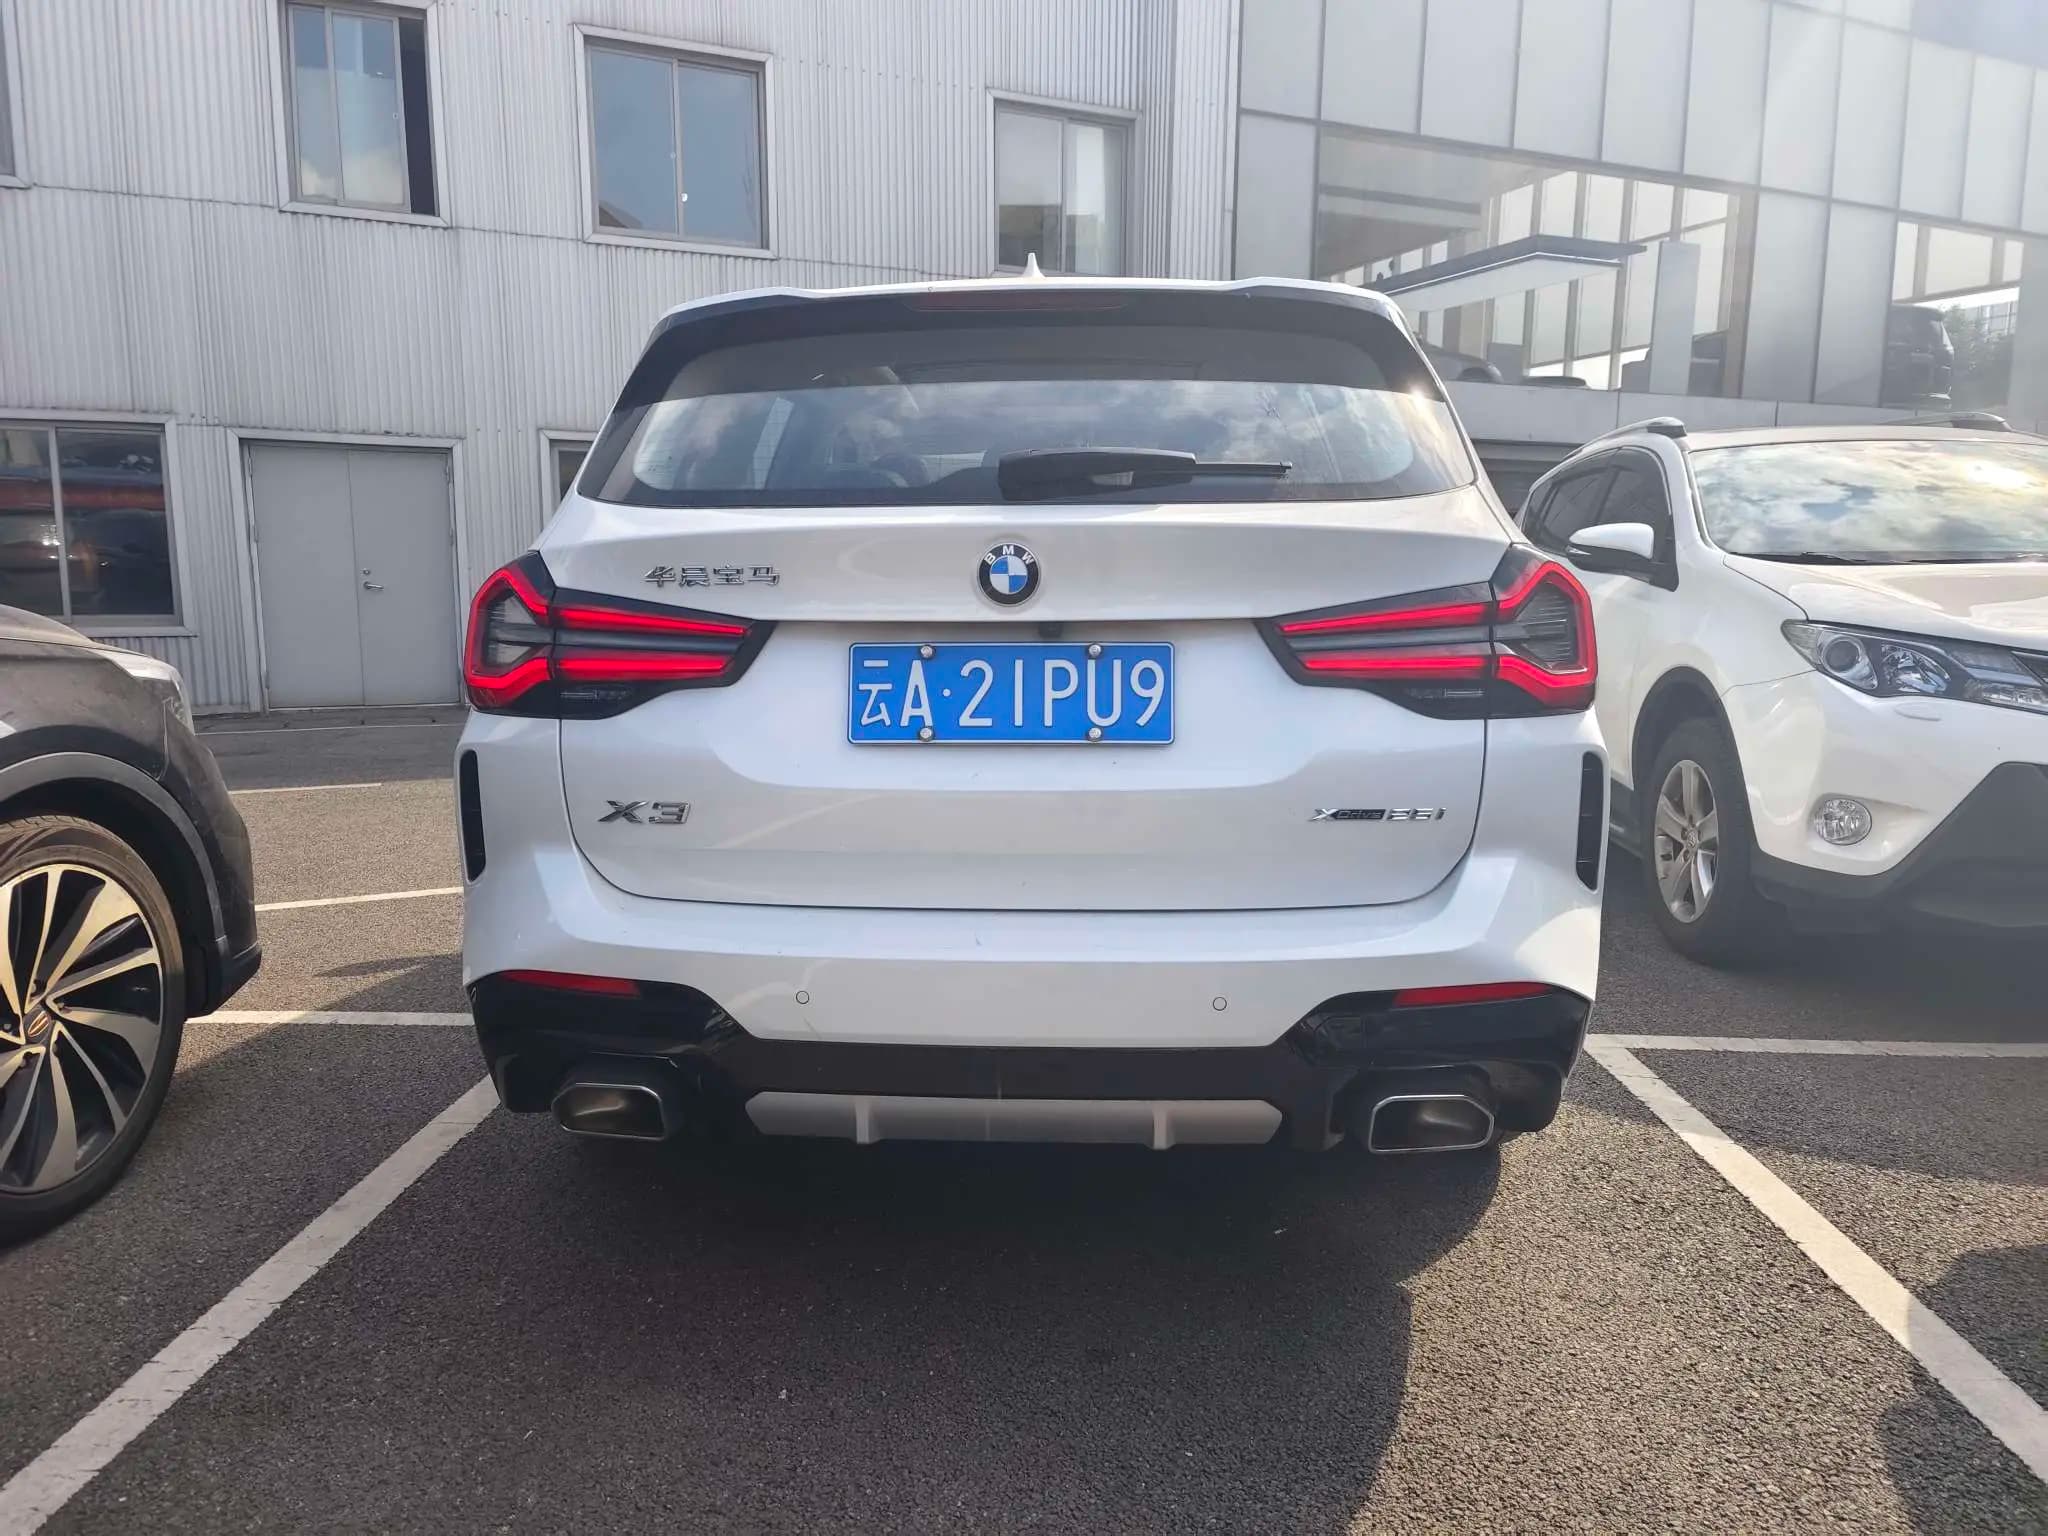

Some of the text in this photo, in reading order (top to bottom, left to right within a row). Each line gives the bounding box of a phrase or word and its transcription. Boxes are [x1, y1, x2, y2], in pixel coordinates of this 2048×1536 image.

[984, 545, 1034, 565] BMW
[644, 565, 781, 587] 华晨宝马
[858, 659, 1165, 727] 云A·21PU9
[598, 800, 691, 824] X3
